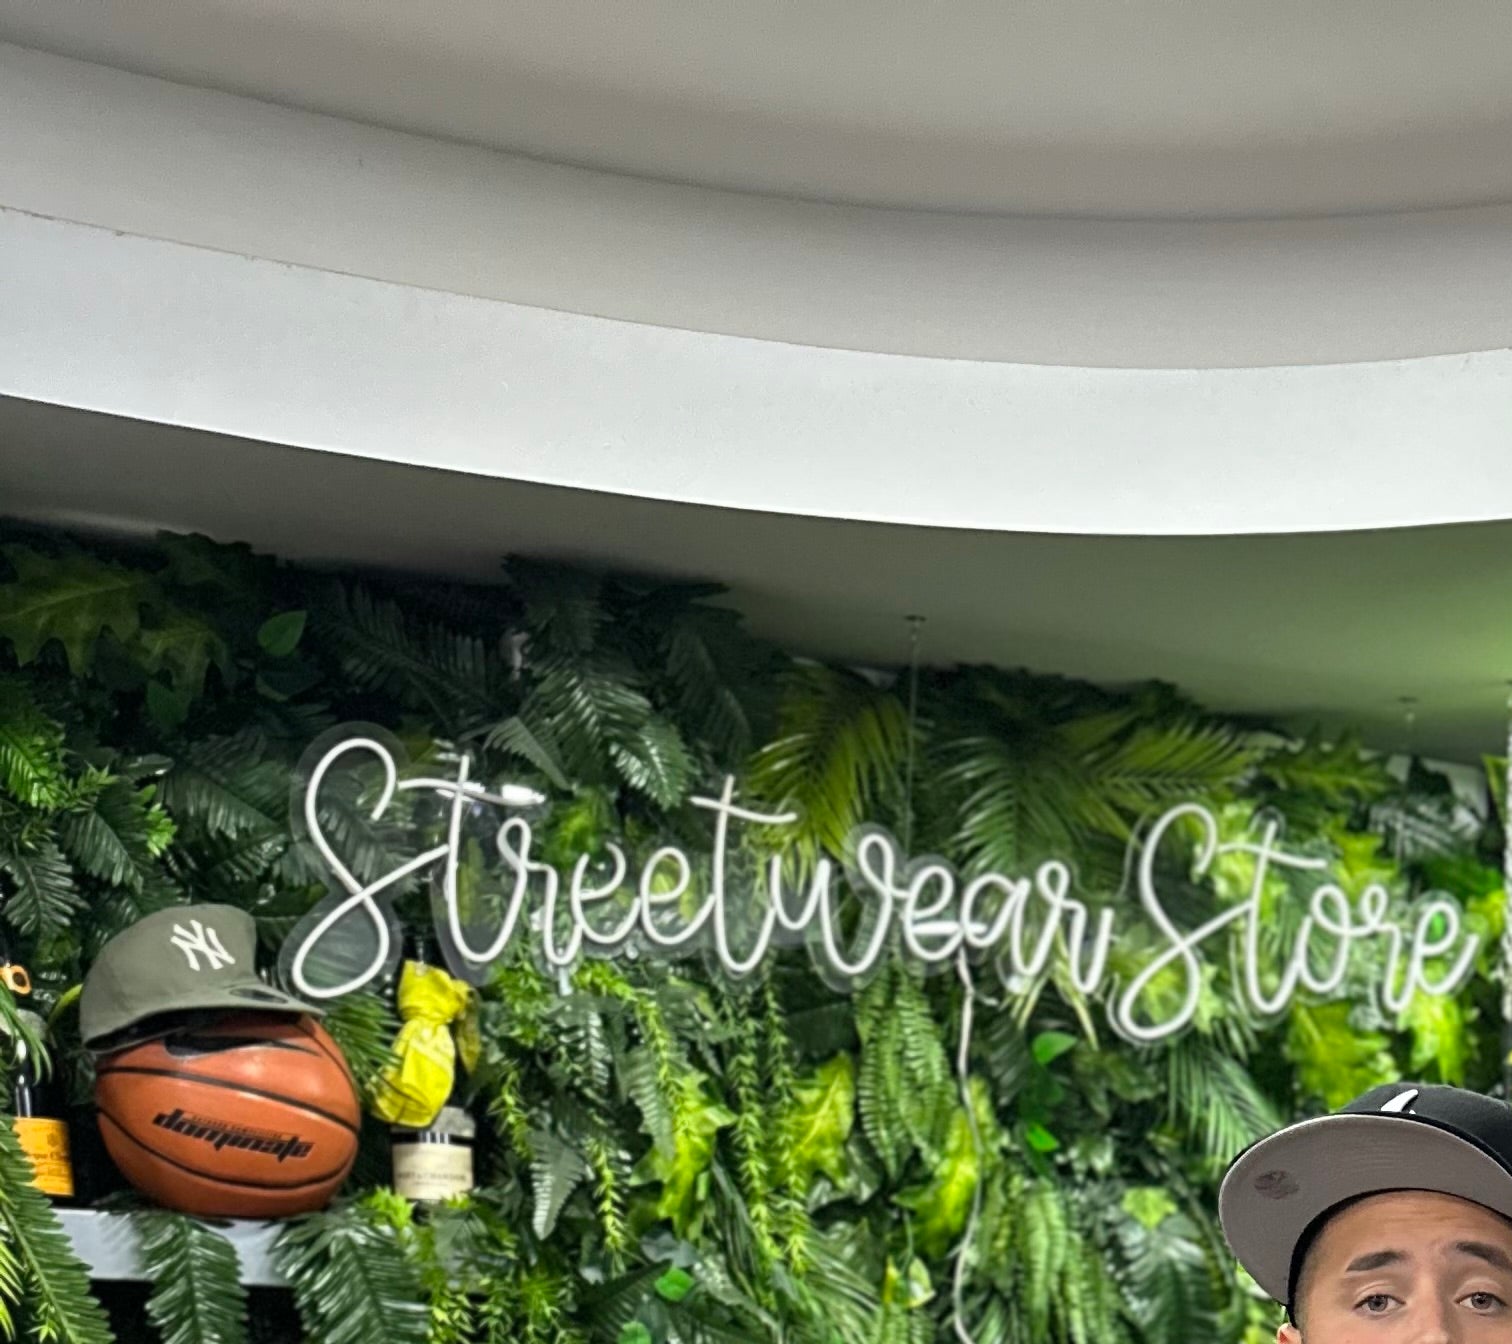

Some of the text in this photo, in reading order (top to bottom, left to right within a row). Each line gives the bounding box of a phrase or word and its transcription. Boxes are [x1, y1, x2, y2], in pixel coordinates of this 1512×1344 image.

[170, 919, 236, 971] NY
[293, 737, 1479, 1040] Streetwear Store
